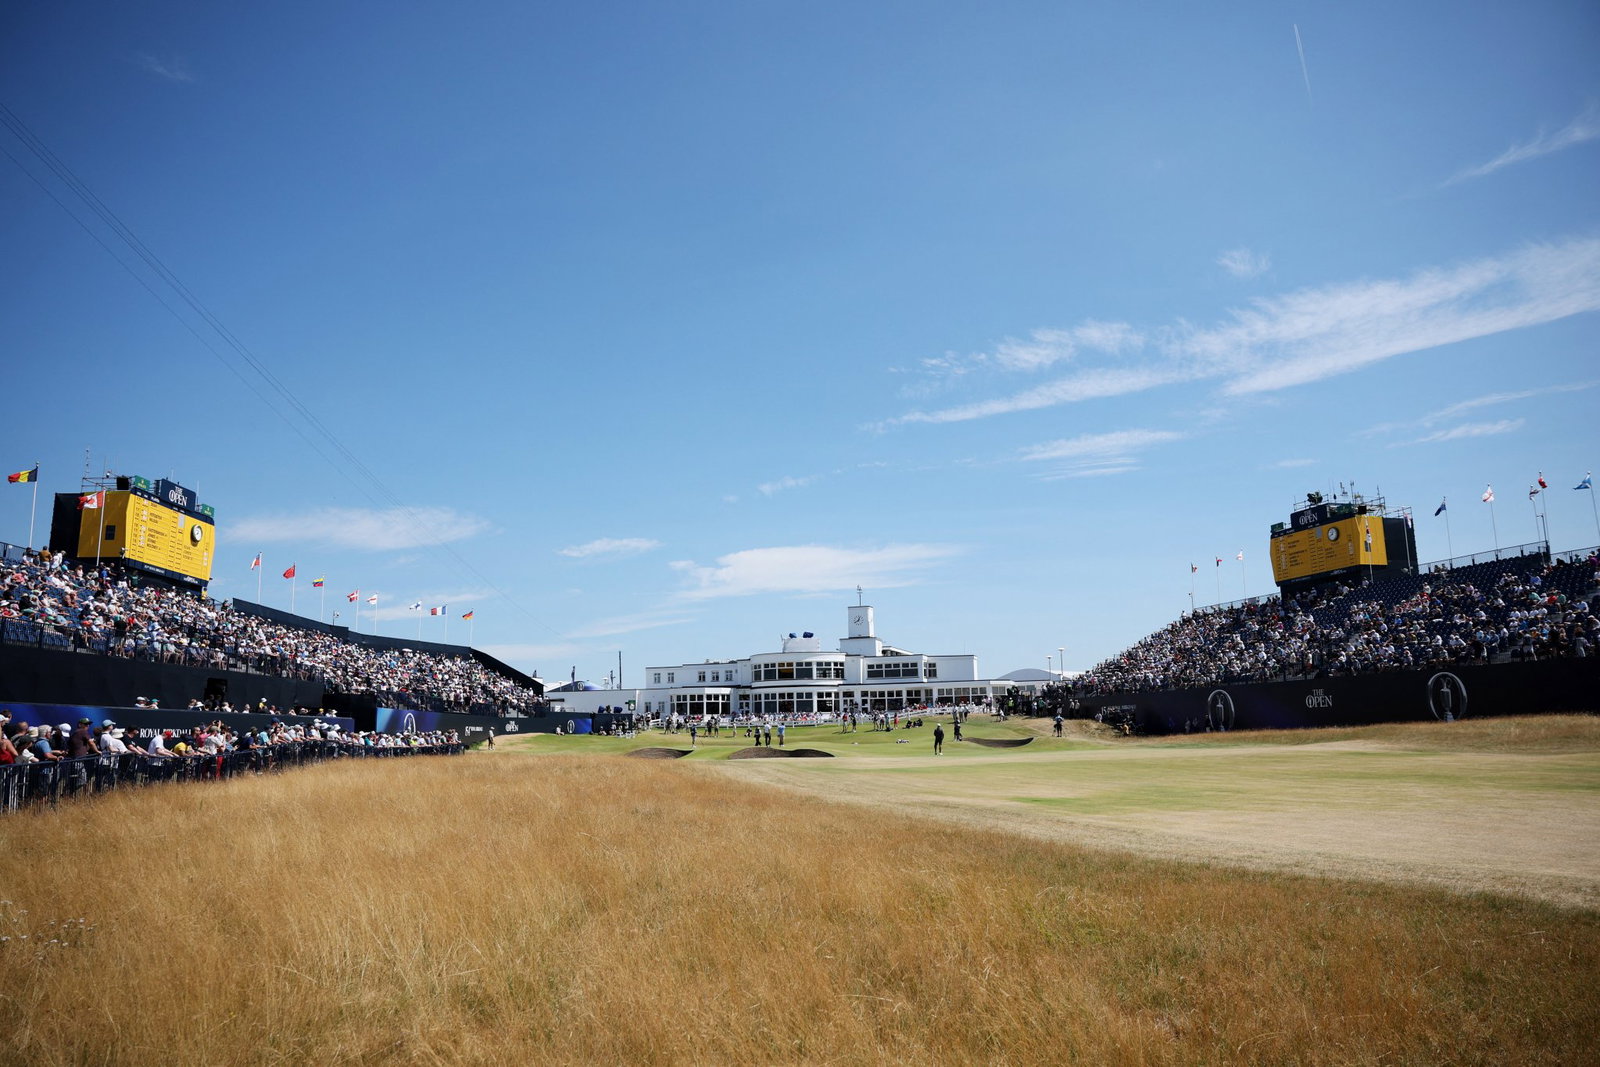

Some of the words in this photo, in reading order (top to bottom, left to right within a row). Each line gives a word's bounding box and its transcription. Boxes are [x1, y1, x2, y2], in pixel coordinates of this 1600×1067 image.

[174, 486, 183, 495] THE
[168, 490, 188, 506] OPEN
[1299, 513, 1318, 525] OPEN
[1306, 695, 1332, 708] OPEN
[140, 728, 161, 738] ROYAL
[505, 724, 519, 732] OPEN
